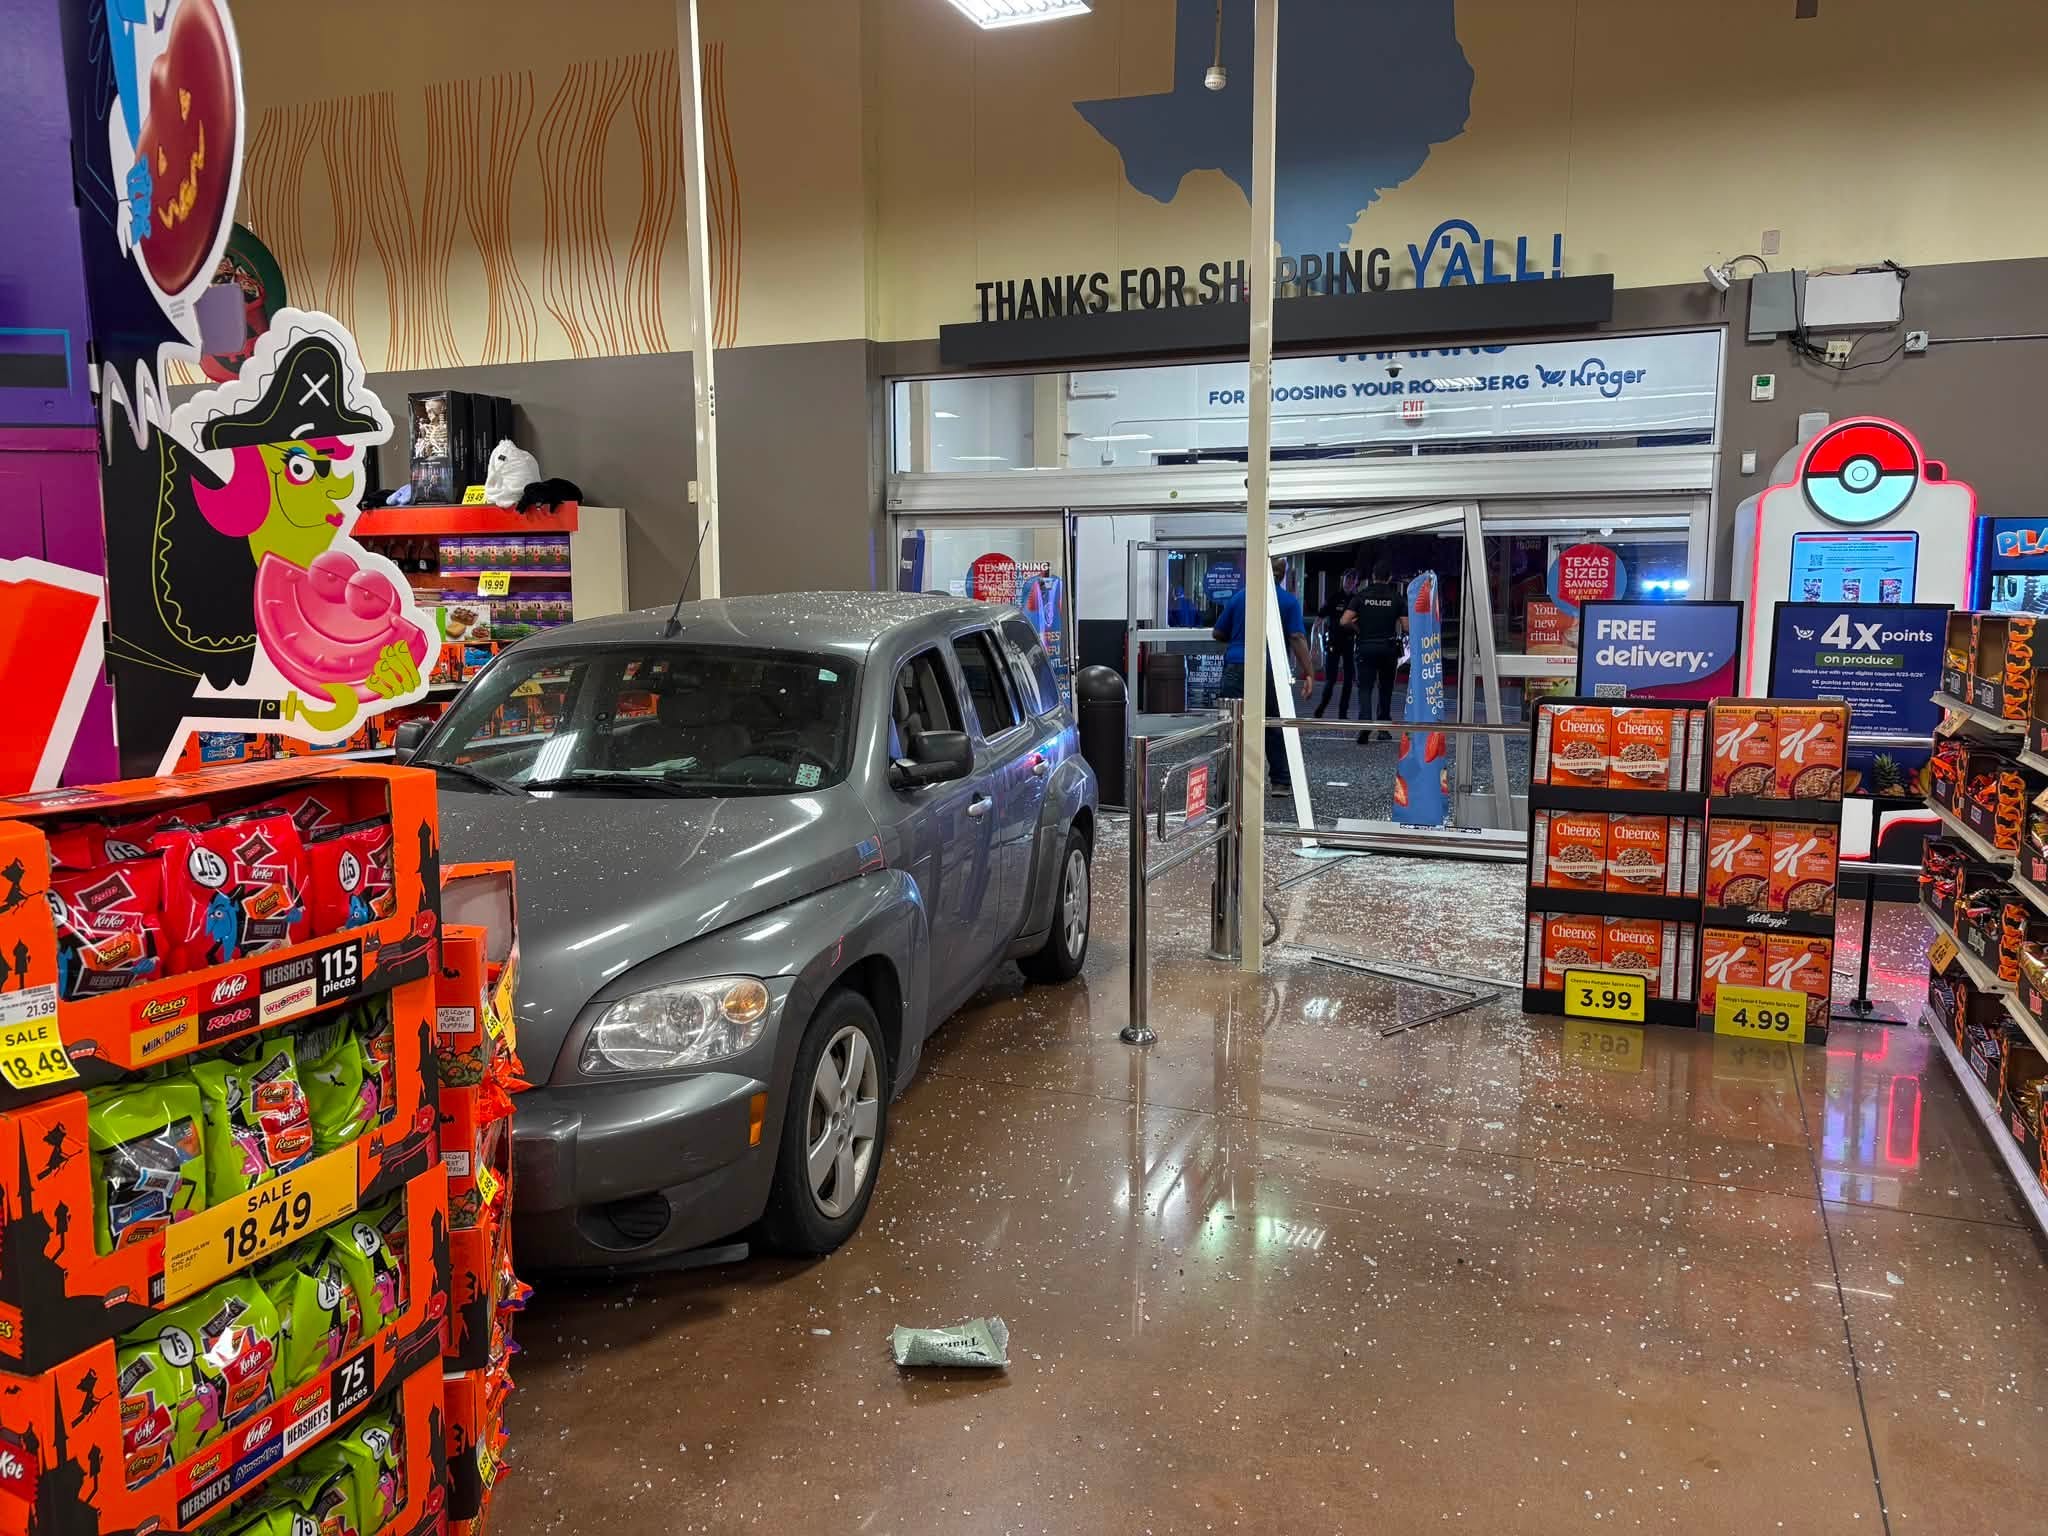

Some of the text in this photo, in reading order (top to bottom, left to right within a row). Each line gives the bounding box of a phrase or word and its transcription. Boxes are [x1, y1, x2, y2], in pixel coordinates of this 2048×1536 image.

[976, 219, 1561, 321] THANKS FOR SHPPING Y'ALL!
[1208, 390, 1245, 405] FOR
[1269, 384, 1347, 402] OOSING
[1351, 380, 1404, 397] YOUR
[1570, 358, 1647, 398] Kroger
[1403, 400, 1425, 418] EXIT
[999, 562, 1049, 571] WARNING
[1566, 556, 1609, 567] TEXAS
[1565, 568, 1609, 579] SIZED
[1565, 579, 1609, 589] SAVINGS
[484, 580, 504, 590] 19.99
[1568, 588, 1604, 596] IN EVERY
[1364, 599, 1393, 607] POLICE
[1533, 603, 1558, 616] Your
[1534, 619, 1558, 629] new
[1597, 619, 1657, 641] FREE
[1530, 630, 1560, 642] ritual
[1881, 629, 1933, 643] points
[1824, 653, 1894, 667] on produce
[1560, 719, 1605, 733] Cheerios
[1617, 721, 1664, 736] Cheerios
[1556, 822, 1601, 838] Cheerios
[1614, 825, 1660, 841] Cheerios
[198, 853, 221, 877] 115
[342, 857, 356, 882] 115
[93, 914, 125, 929] KitKat
[1746, 912, 1789, 928] Kellogg's
[1552, 924, 1597, 940] Cheerios
[1609, 928, 1655, 945] Cheerios
[264, 945, 357, 987] HERSHEY'S 115
[211, 974, 248, 1003] KitKat
[323, 976, 356, 997] pieces
[26, 1001, 56, 1018] 21.99
[141, 996, 188, 1020] Reese's
[265, 986, 312, 1014] WHOPPERS
[1580, 988, 1632, 1011] 3.99
[207, 1008, 252, 1031] Rolo
[1732, 1007, 1790, 1032] 4.99
[5, 1026, 48, 1047] SALE
[142, 1022, 189, 1056] Milk Duds
[3, 1048, 68, 1081] 18.49
[247, 1179, 292, 1213] SALE
[223, 1191, 312, 1265] 18.49
[166, 1332, 188, 1357] 75
[341, 1355, 366, 1397] 75
[292, 1387, 323, 1416] Reese's
[337, 1385, 368, 1417] pieces
[243, 1417, 273, 1450] KitKat
[286, 1403, 330, 1447] HERSHEY'S
[189, 1454, 221, 1481] Reese's
[181, 1475, 231, 1523] HERSHEY'S
